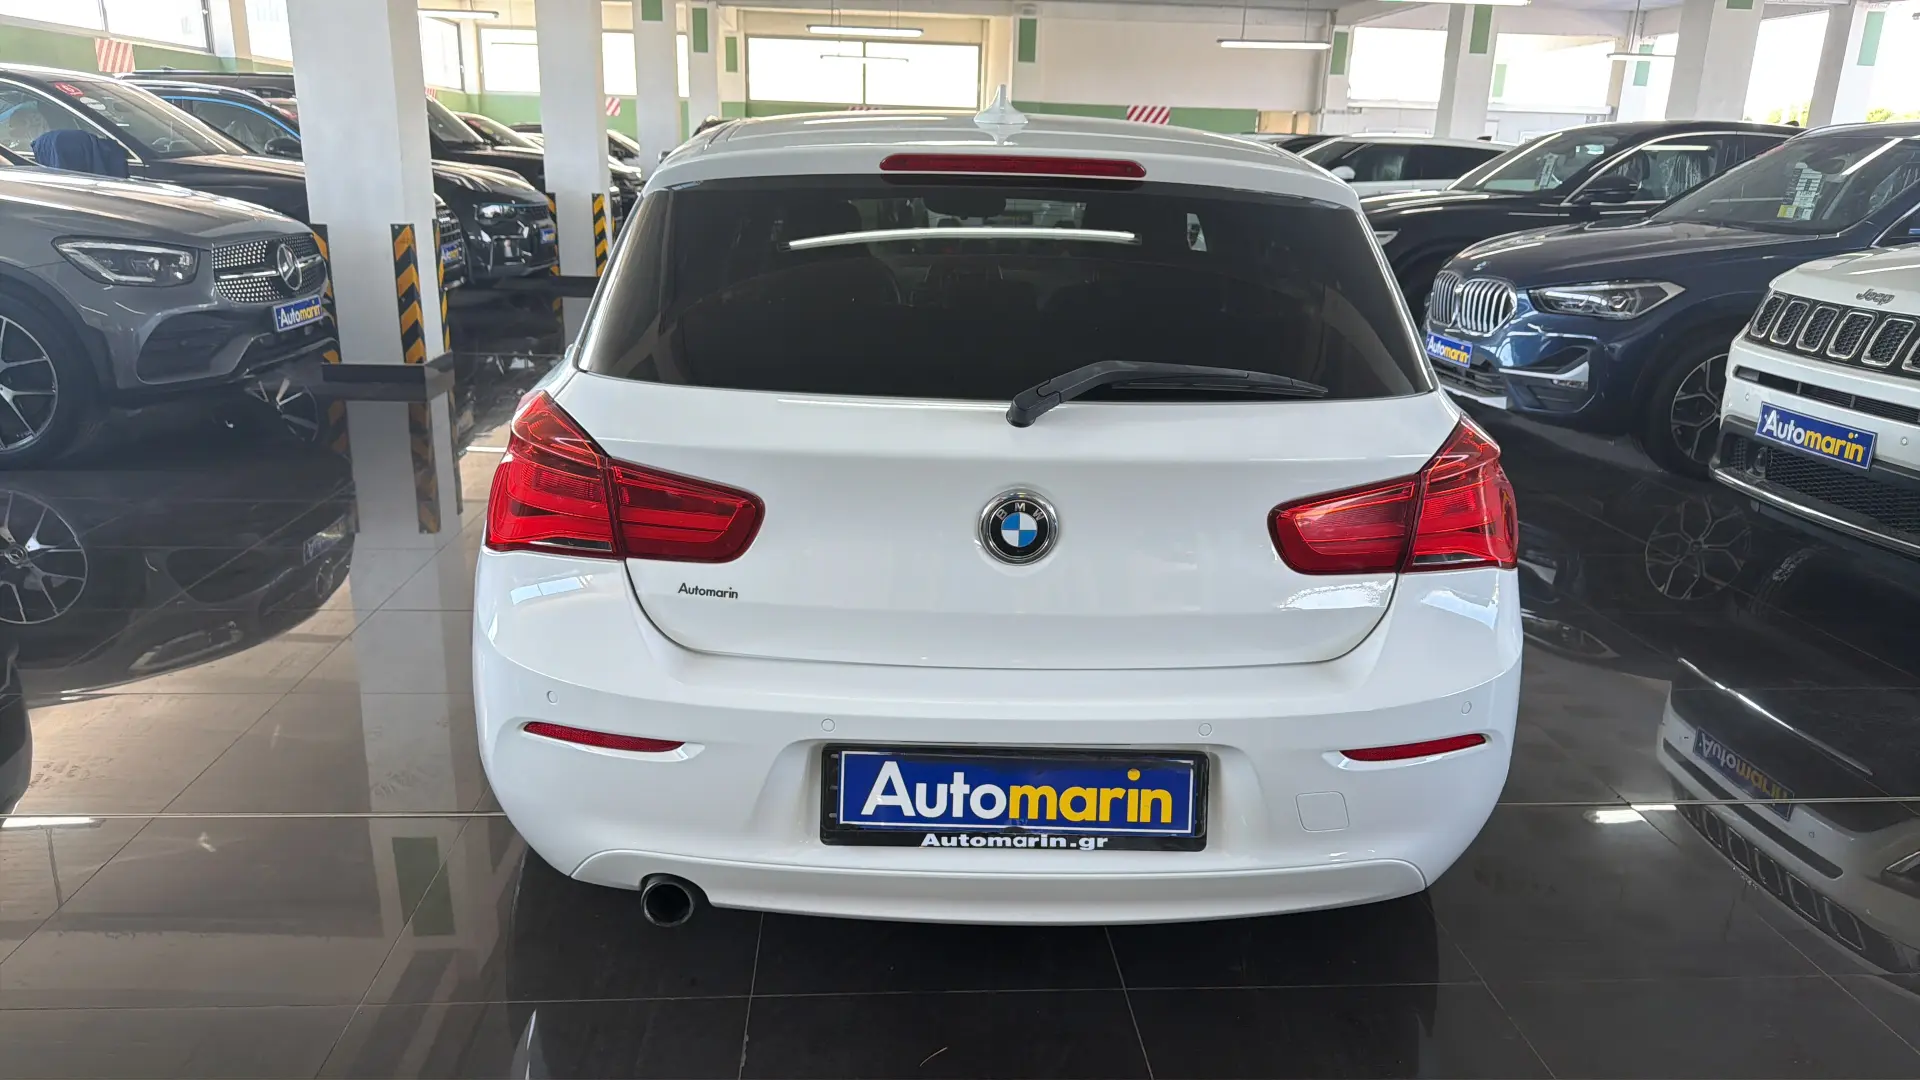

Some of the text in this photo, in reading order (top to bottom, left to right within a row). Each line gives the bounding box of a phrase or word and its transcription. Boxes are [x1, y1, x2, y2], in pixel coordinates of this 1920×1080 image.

[1856, 288, 1895, 306] Jeep
[281, 299, 320, 327] Automarin
[1427, 335, 1468, 364] Automarin
[1762, 409, 1865, 462] Automarin
[995, 502, 1046, 521] BMW
[677, 582, 739, 599] Automarin
[860, 760, 1173, 824] Automarin
[920, 832, 1108, 850] Automarin.gr
